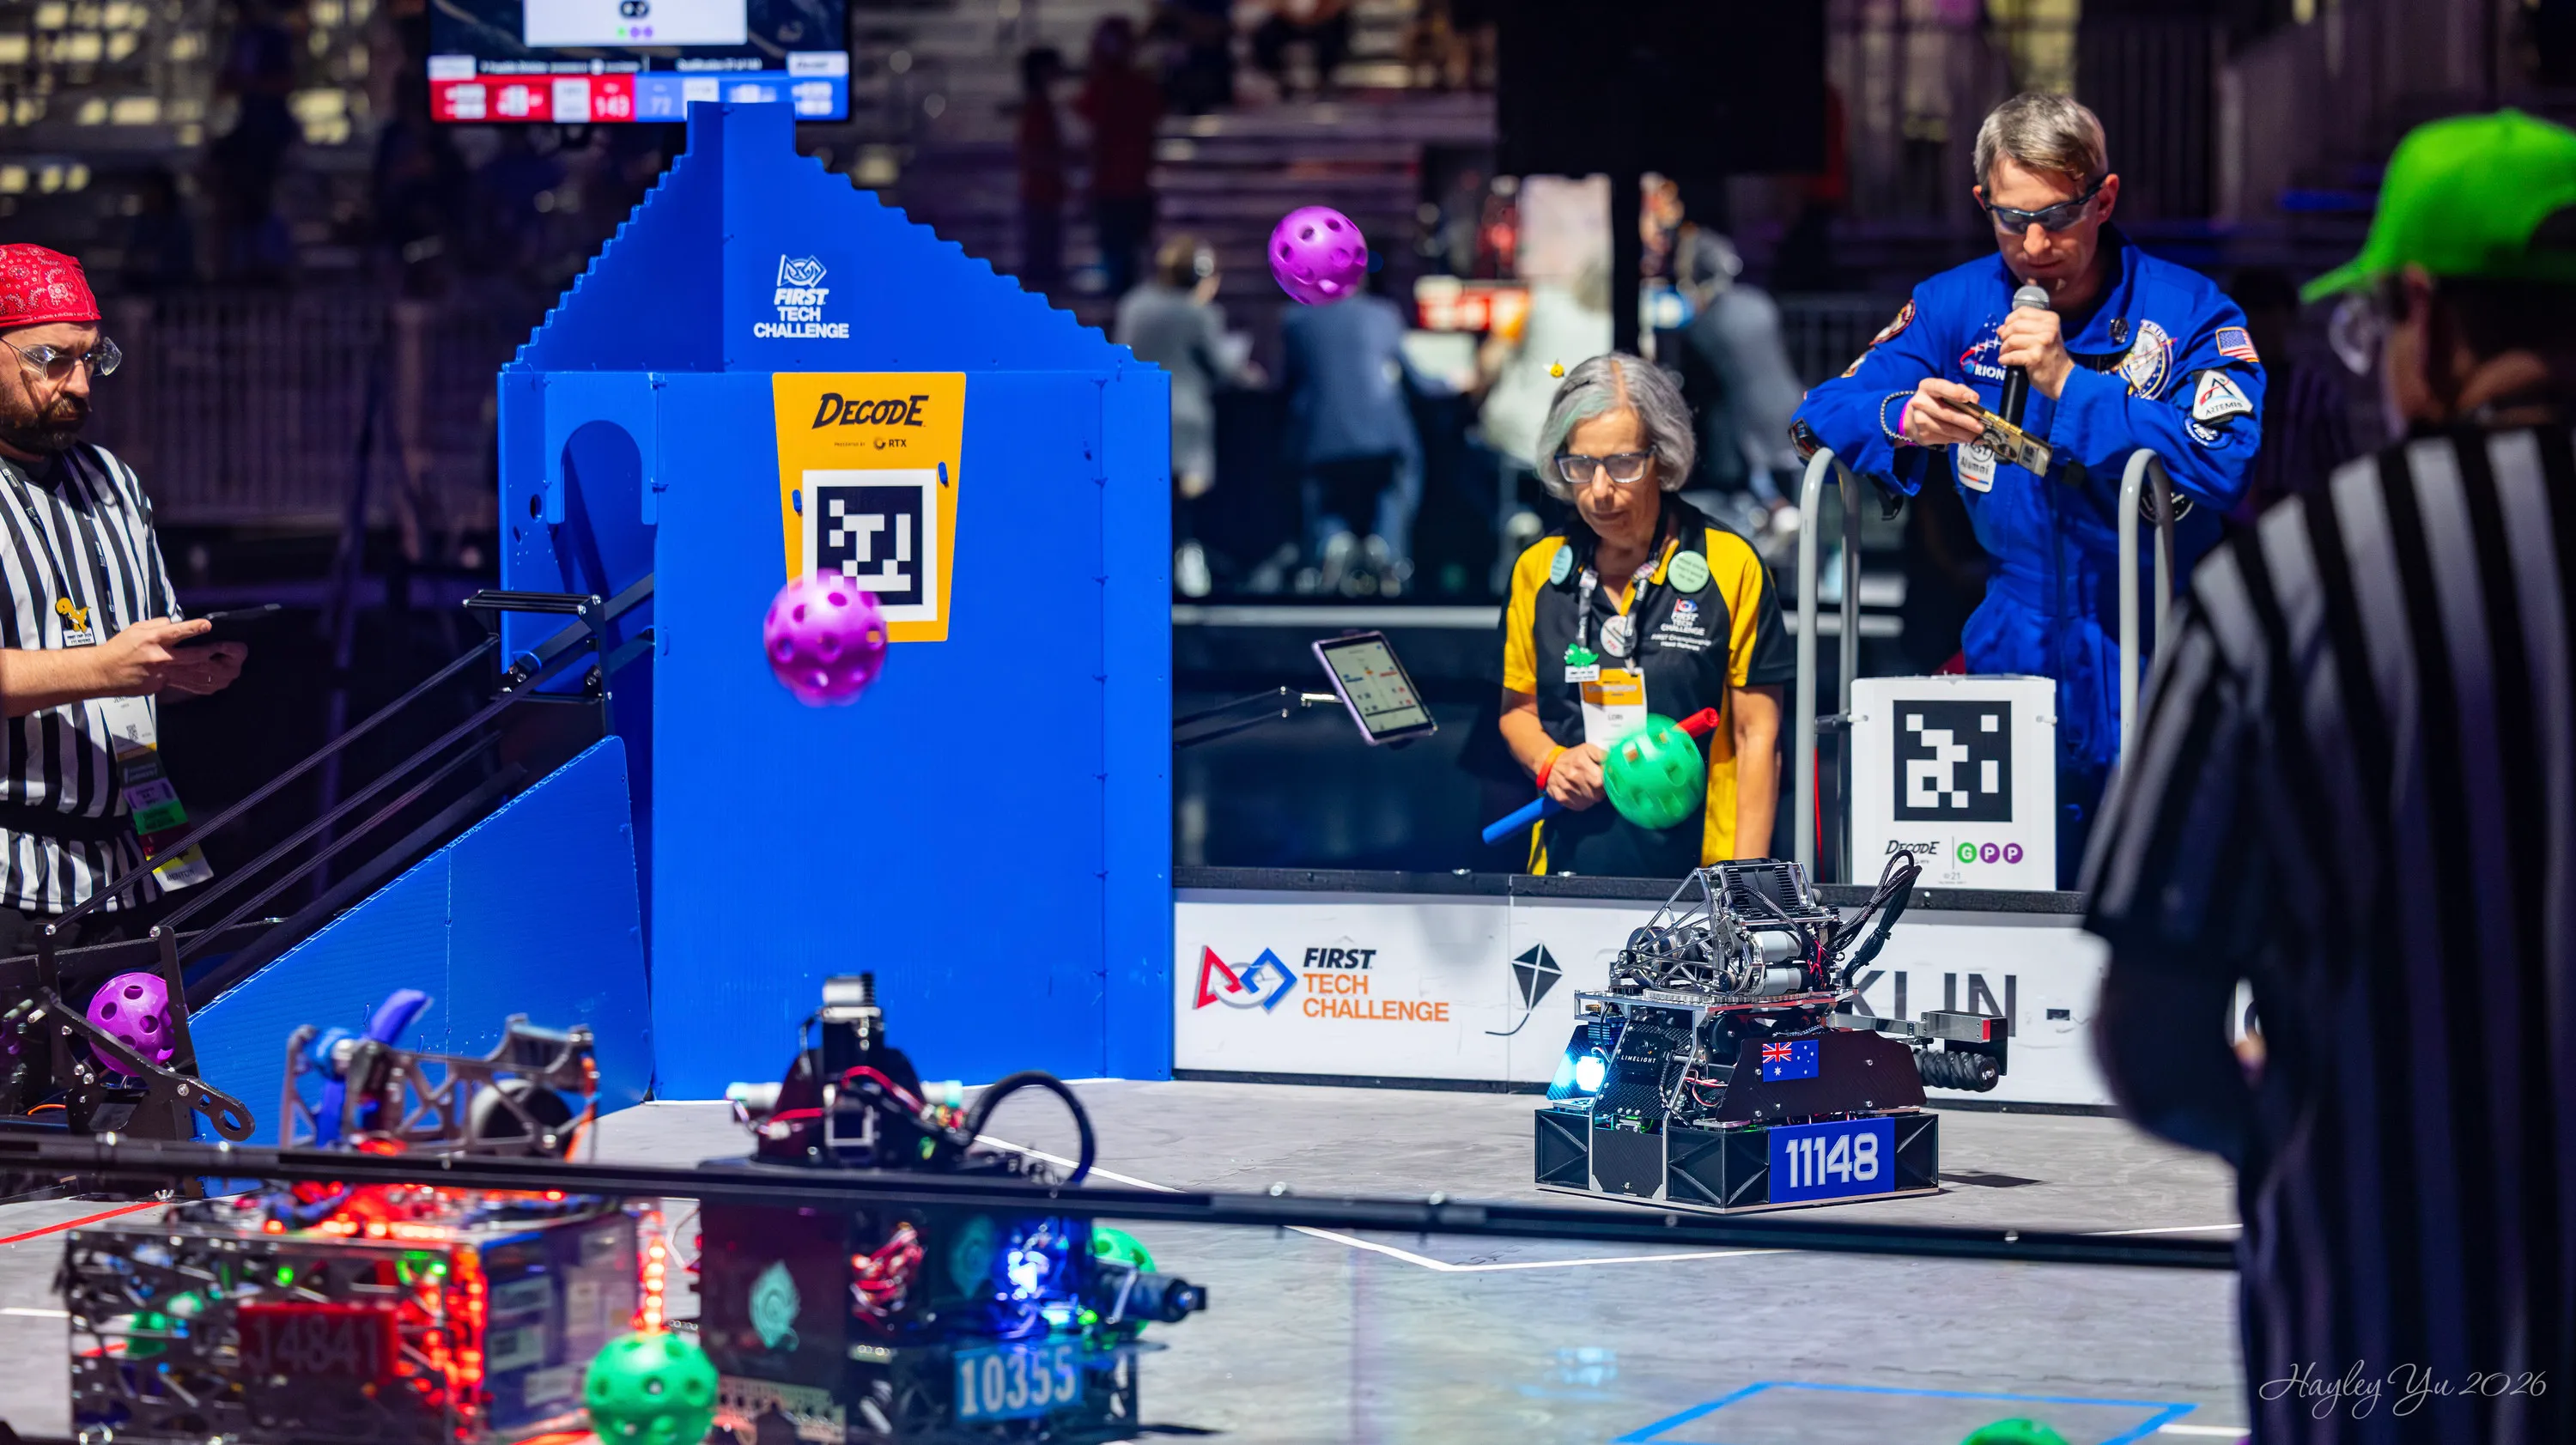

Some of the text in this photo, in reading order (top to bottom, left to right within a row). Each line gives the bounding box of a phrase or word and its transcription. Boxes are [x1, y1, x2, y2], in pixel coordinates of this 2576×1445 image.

[774, 288, 829, 306] FIRST
[777, 307, 821, 322] TECH
[753, 322, 850, 338] CHALLENGE
[811, 392, 929, 429] DECODE
[889, 439, 907, 447] RTX
[1959, 457, 1990, 476] Alumni
[1660, 623, 1705, 635] CHALLENGE
[1885, 840, 1940, 855] DECODE
[1951, 871, 1961, 880] 21
[1303, 947, 1376, 970] FIRST
[1303, 973, 1369, 995] TECH
[1303, 999, 1449, 1023] CHALLENGE
[1620, 1054, 1656, 1064] LIMELIGHT
[1785, 1132, 1880, 1188] 11148
[960, 1345, 1076, 1416] 10355
